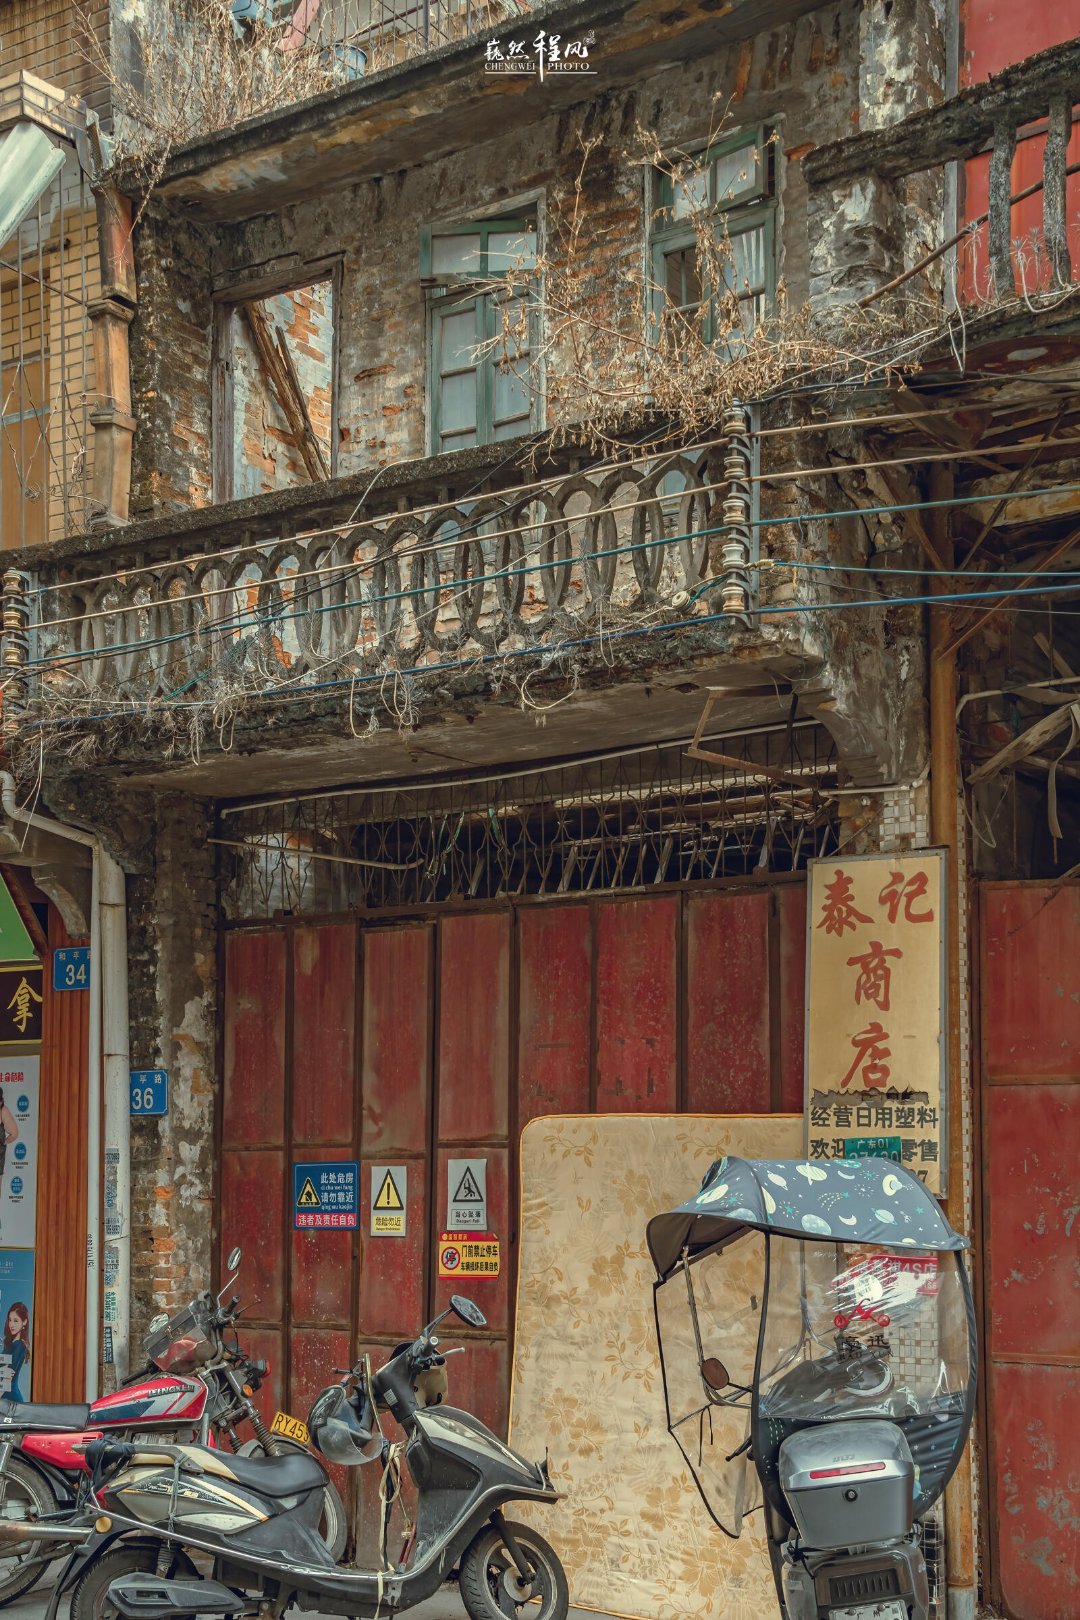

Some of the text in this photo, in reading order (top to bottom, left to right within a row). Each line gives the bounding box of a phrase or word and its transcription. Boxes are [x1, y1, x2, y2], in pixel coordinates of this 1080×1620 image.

[816, 869, 935, 938] 泰记
[65, 963, 86, 985] 34
[7, 976, 43, 1032] 拿
[840, 941, 903, 1089] 商店
[132, 1087, 154, 1109] 36
[810, 1105, 939, 1129] 经营日用塑料
[320, 1172, 354, 1184] 此处危房
[321, 1191, 354, 1203] 请勿靠近
[462, 1244, 498, 1258] 门前禁止停车
